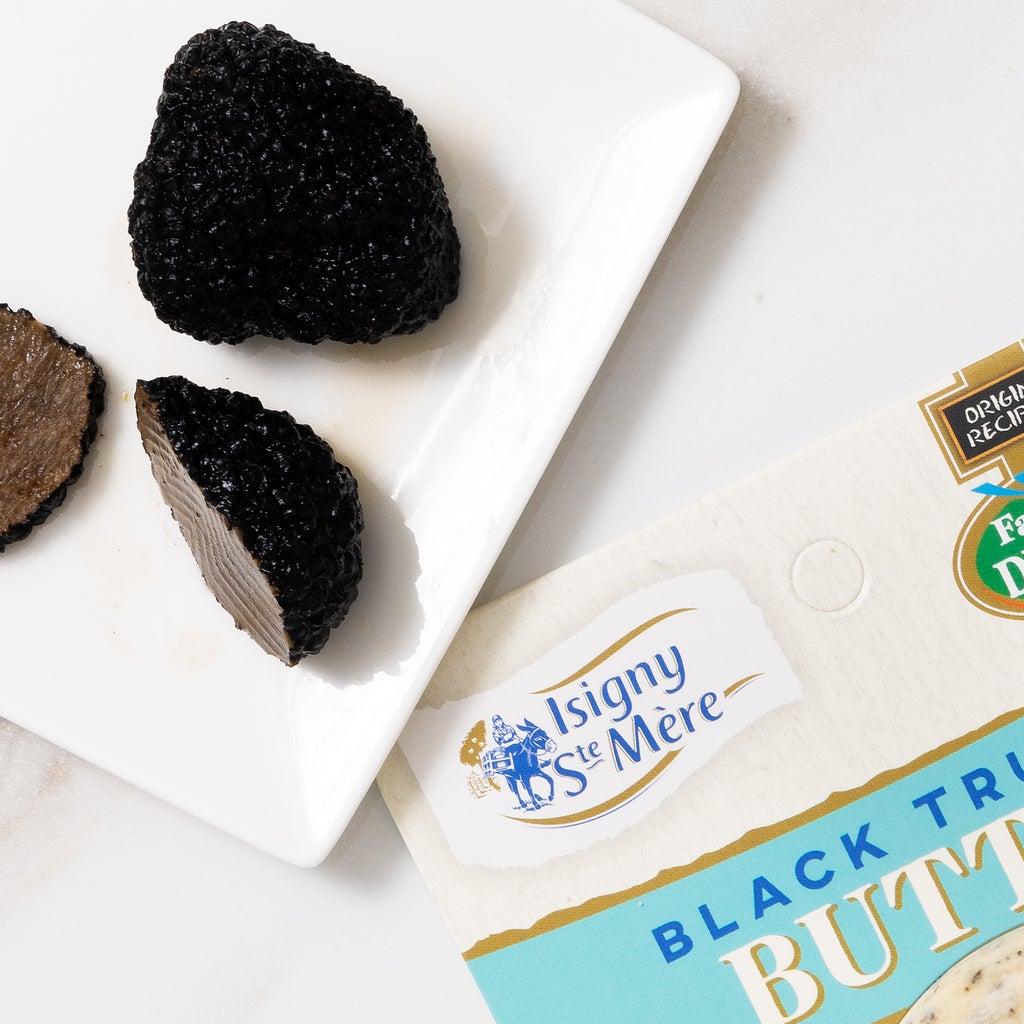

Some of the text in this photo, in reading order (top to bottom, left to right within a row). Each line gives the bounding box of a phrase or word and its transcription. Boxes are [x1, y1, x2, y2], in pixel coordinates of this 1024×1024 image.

[544, 645, 686, 735] Isigny
[552, 689, 724, 797] Ste Mère
[652, 823, 889, 963] BLACK
